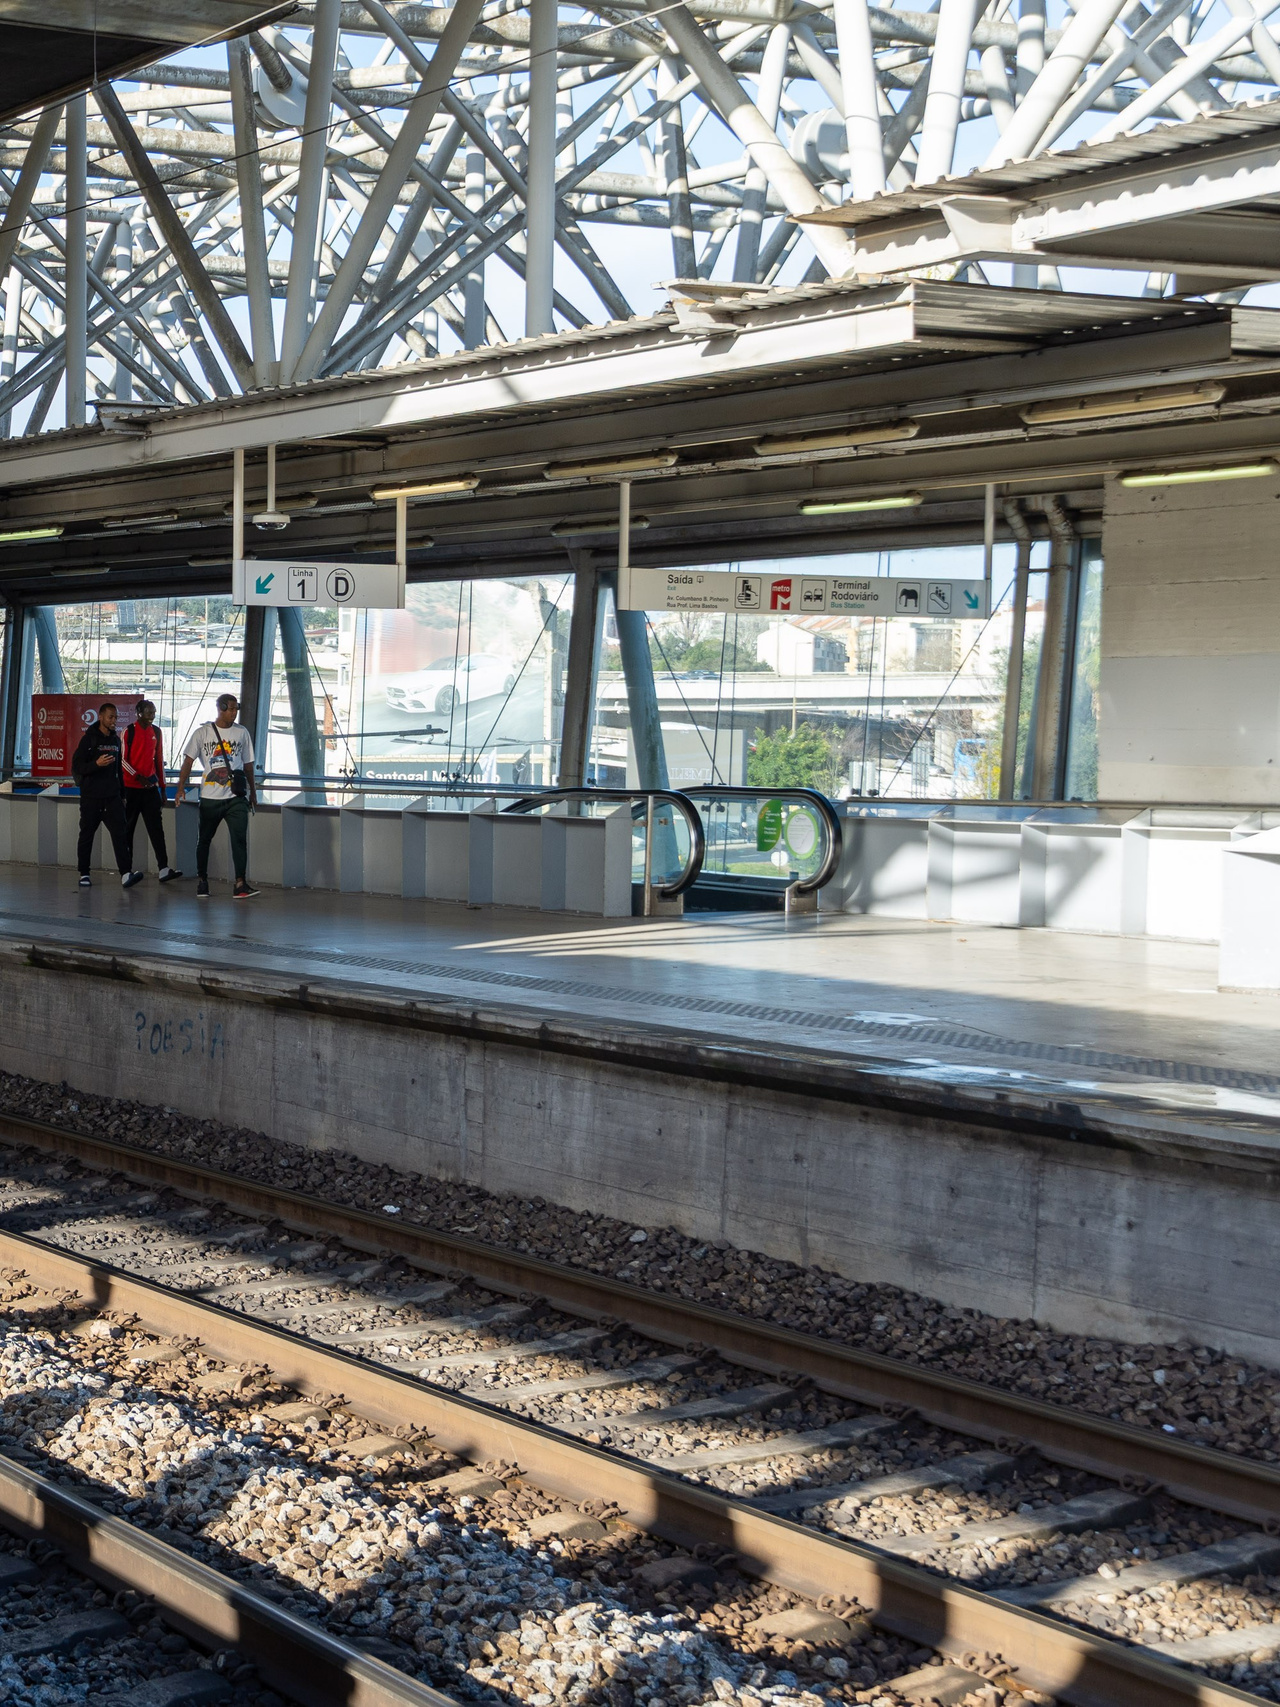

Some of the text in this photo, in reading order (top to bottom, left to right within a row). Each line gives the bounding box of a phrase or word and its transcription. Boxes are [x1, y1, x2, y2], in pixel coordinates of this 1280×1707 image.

[293, 569, 313, 577] Linha
[667, 573, 693, 585] Saída
[297, 579, 306, 599] 1
[334, 577, 349, 596] D
[771, 584, 791, 593] metro
[832, 579, 871, 590] Terminal
[830, 590, 879, 602] Rodoviário
[37, 737, 50, 746] COLD
[37, 748, 64, 761] DRINKS
[365, 770, 428, 782] Santogal
